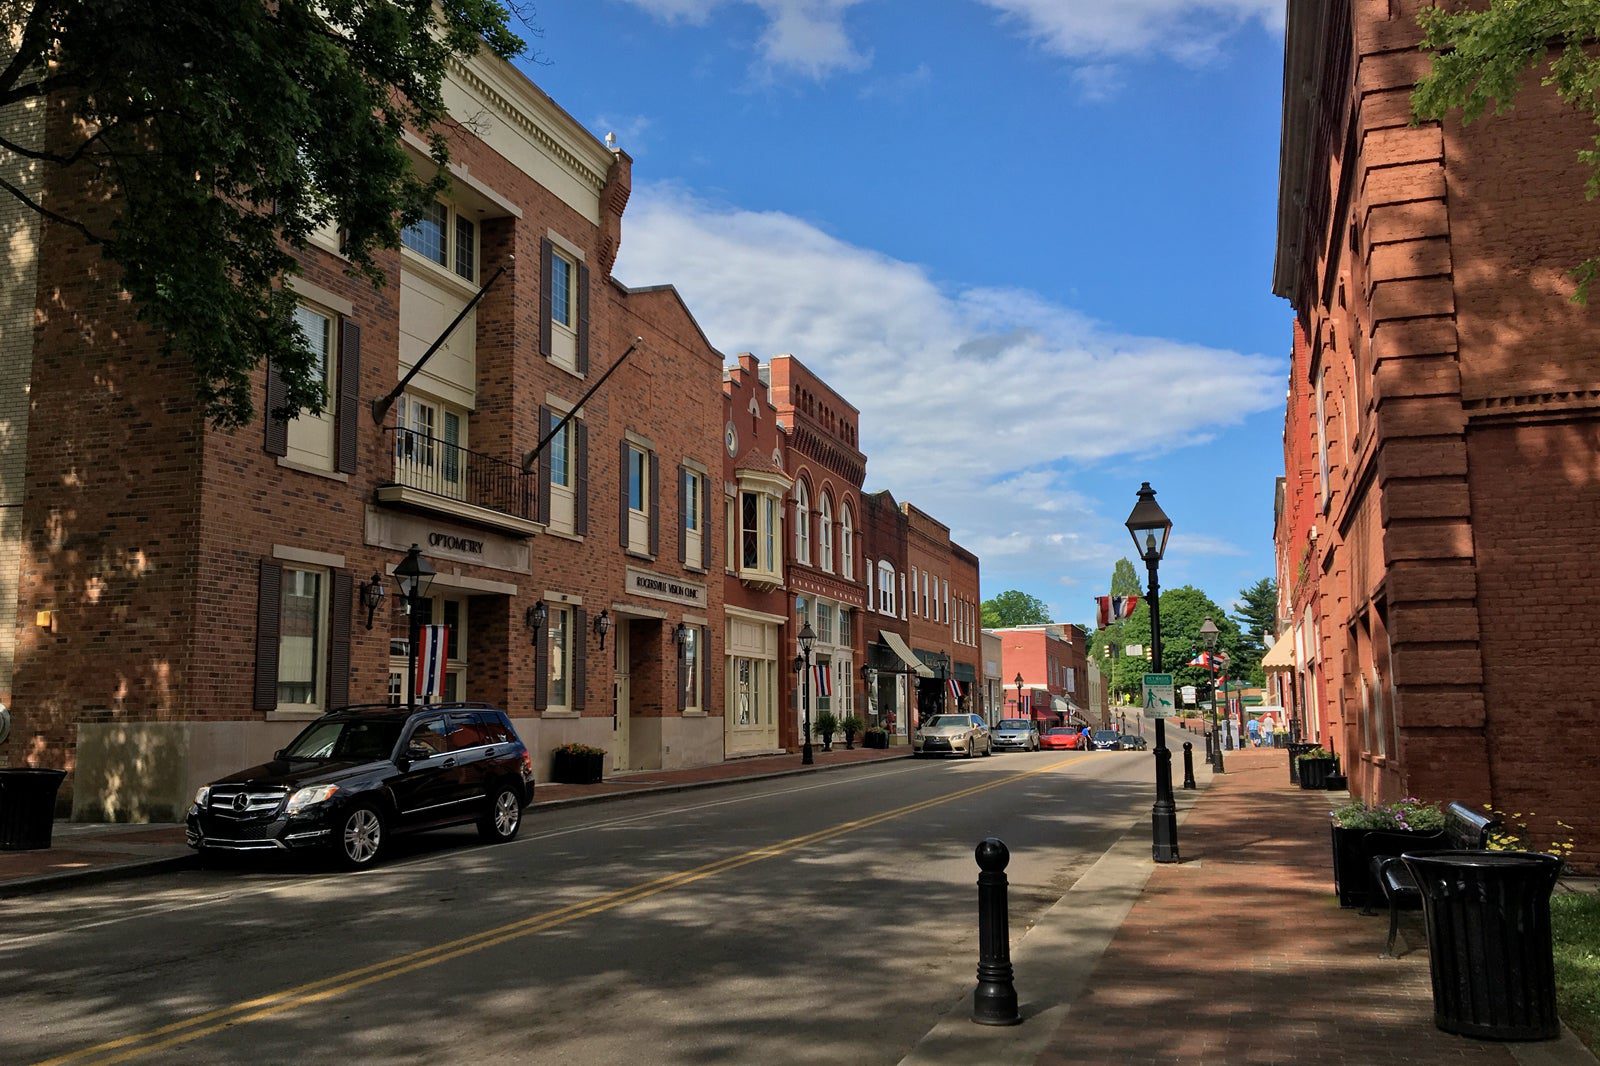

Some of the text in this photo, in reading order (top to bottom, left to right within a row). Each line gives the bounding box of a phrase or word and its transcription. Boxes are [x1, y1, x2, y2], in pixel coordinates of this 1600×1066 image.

[429, 532, 484, 554] OPTOMETRY
[636, 576, 699, 599] ROGERSVILLE VISION CLINIC
